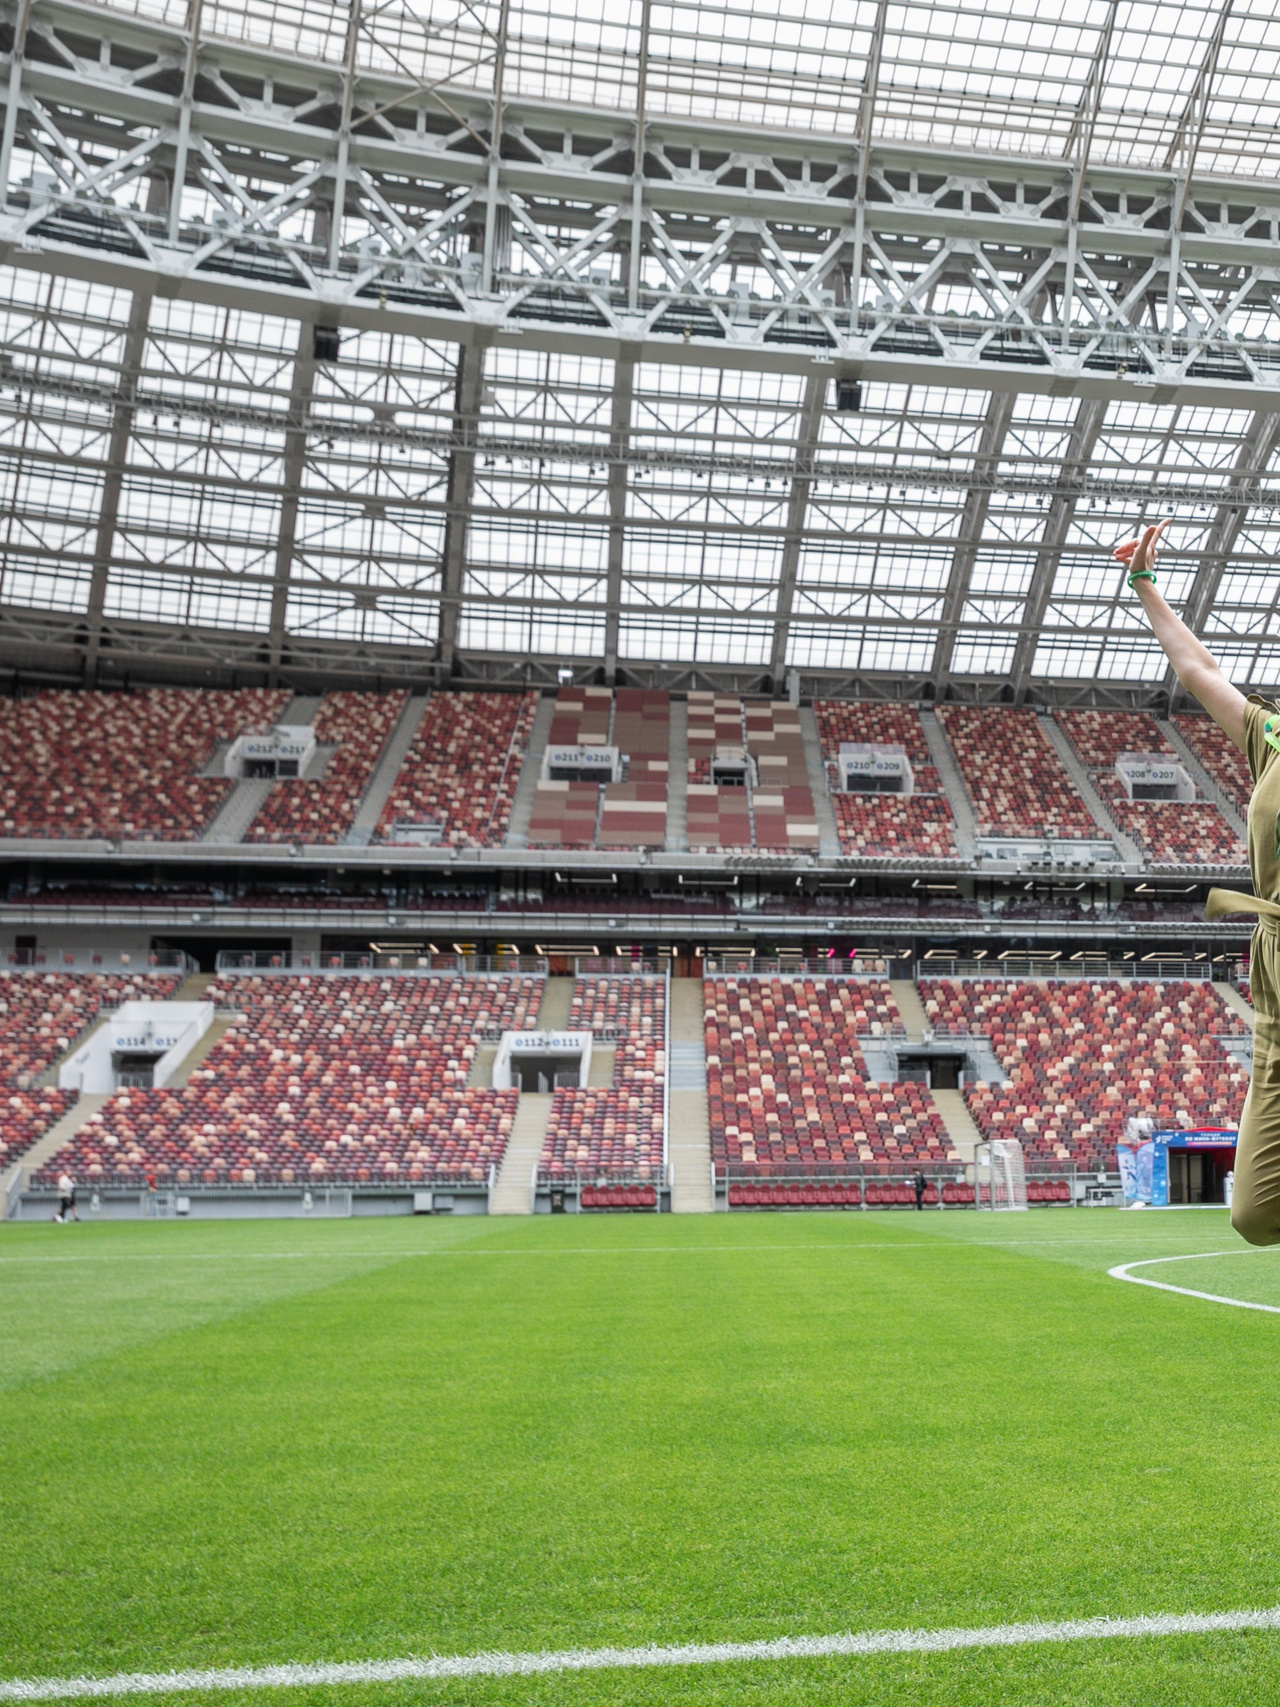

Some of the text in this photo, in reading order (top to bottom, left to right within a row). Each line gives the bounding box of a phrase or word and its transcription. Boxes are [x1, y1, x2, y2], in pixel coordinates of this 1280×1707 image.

[562, 752, 611, 763] 211 210
[853, 761, 900, 771] 210 209
[1130, 770, 1175, 779] 208 207
[524, 1037, 580, 1047] 112 111
